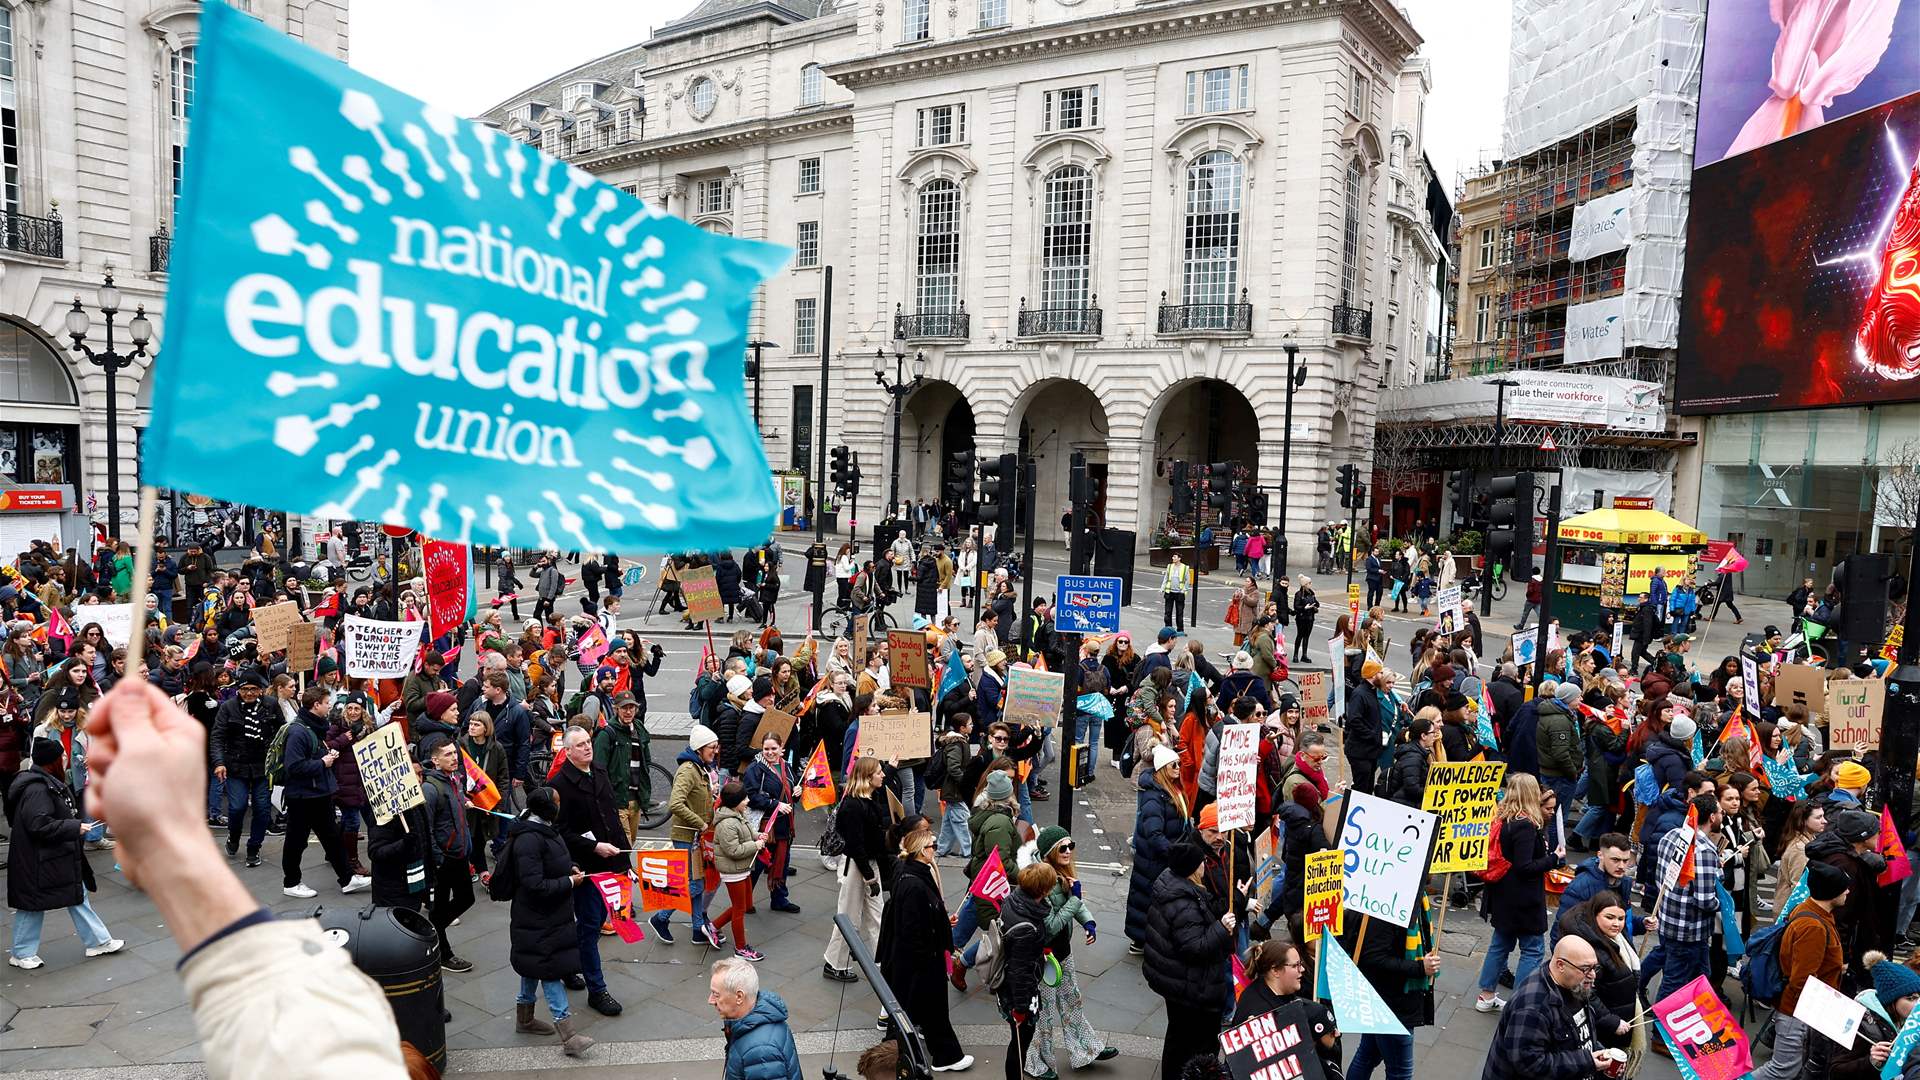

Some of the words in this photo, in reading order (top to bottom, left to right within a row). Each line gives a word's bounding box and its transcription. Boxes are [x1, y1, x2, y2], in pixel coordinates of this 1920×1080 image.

[389, 215, 611, 318] national
[224, 258, 716, 411] education
[1582, 325, 1610, 340] Wates
[1550, 381, 1594, 391] constructors
[1533, 389, 1554, 399] their
[1556, 392, 1604, 403] workforce
[413, 402, 583, 468] union
[1561, 528, 1580, 538] HOT
[1583, 530, 1603, 540] DOG
[1630, 570, 1646, 578] HOT
[1665, 569, 1686, 579] SPOT
[1064, 579, 1085, 588] BUS
[1088, 580, 1114, 590] LANE
[1557, 584, 1577, 594] HOT
[1580, 586, 1601, 597] DOG
[1059, 609, 1086, 618] LOOK
[1089, 611, 1116, 620] BOTH
[356, 625, 403, 636] TEACHER
[1074, 620, 1101, 630] WAYS
[355, 633, 403, 644] BURNOUT
[355, 642, 363, 650] IS
[364, 643, 386, 652] WHY
[387, 644, 401, 652] WE
[889, 633, 923, 657] Standing
[355, 650, 379, 660] HAVE
[381, 652, 400, 660] THIS
[899, 661, 911, 673] for
[1300, 688, 1311, 701] THE
[1847, 704, 1871, 718] our
[863, 721, 885, 732] THIS
[888, 720, 907, 730] SIGN
[912, 719, 921, 728] IS
[1833, 719, 1884, 744] schools
[357, 741, 377, 766] IF
[384, 731, 396, 749] U
[893, 744, 905, 752] AM
[1220, 754, 1233, 767] THIS
[361, 756, 387, 783] KEPE
[1428, 765, 1503, 786] KNOWLEDGE
[365, 782, 376, 799] IN
[401, 785, 420, 803] LIKE
[1432, 790, 1448, 807] IS
[1471, 804, 1494, 819] WHY
[1344, 805, 1412, 863] Save
[1451, 822, 1490, 840] TORIES
[1433, 842, 1453, 864] AR
[1459, 839, 1485, 861] US!
[1307, 862, 1327, 880] Strike
[1330, 861, 1342, 875] for
[1344, 848, 1394, 876] Our
[1306, 876, 1342, 895] education
[1694, 992, 1742, 1043] PAY
[1220, 1012, 1278, 1056] LEARN
[1251, 1023, 1302, 1063] FROM
[1250, 1054, 1303, 1080] WALT
